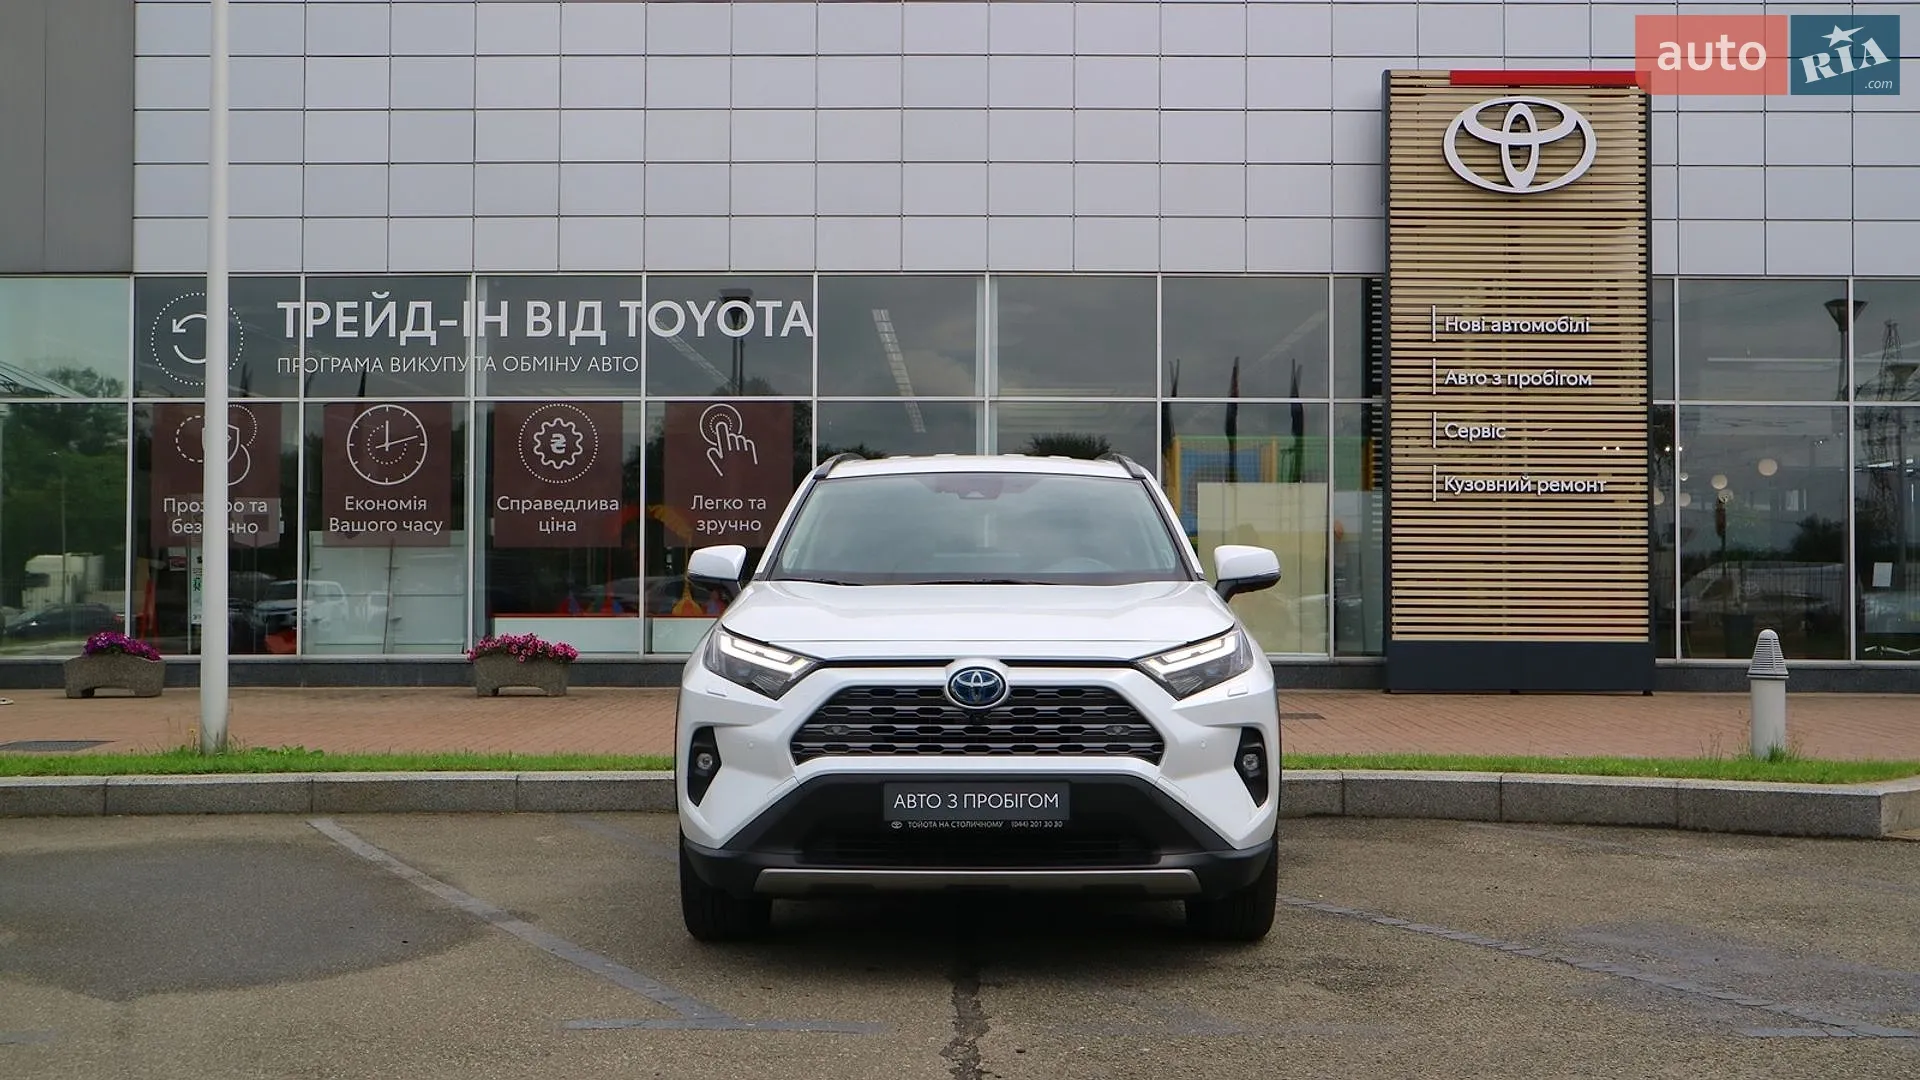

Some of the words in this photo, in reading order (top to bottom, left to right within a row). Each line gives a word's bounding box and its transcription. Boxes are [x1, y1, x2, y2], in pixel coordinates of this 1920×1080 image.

[277, 291, 508, 346] ТРЕЙД-ІН
[526, 300, 607, 346] ВІД
[619, 300, 814, 338] TOYOTA
[1445, 316, 1485, 332] Нові
[1491, 316, 1590, 333] автомобілі
[277, 357, 384, 373] ПРОГРАМА
[391, 356, 469, 373] ВИКУПУ
[473, 356, 497, 372] ТА
[502, 356, 582, 373] ОБМІНУ
[587, 356, 640, 373] АВТО
[1445, 369, 1487, 385] Авто
[1492, 373, 1502, 385] з
[1507, 369, 1593, 388] пробігом
[1444, 422, 1507, 442] Сервіс
[1444, 475, 1532, 495] Кузовний
[1537, 480, 1607, 495] ремонт
[249, 501, 268, 513] та
[345, 496, 427, 511] Економія
[496, 495, 619, 512] Справедлива
[690, 495, 743, 510] Легко
[747, 499, 767, 510] та
[329, 516, 398, 532] Вашого
[403, 521, 443, 535] часу
[538, 517, 577, 535] ціна
[696, 519, 762, 535] зручно
[893, 793, 942, 809] АВТО
[963, 793, 1059, 809] ПРОБІГОМ
[908, 821, 937, 829] ТОЙОТА
